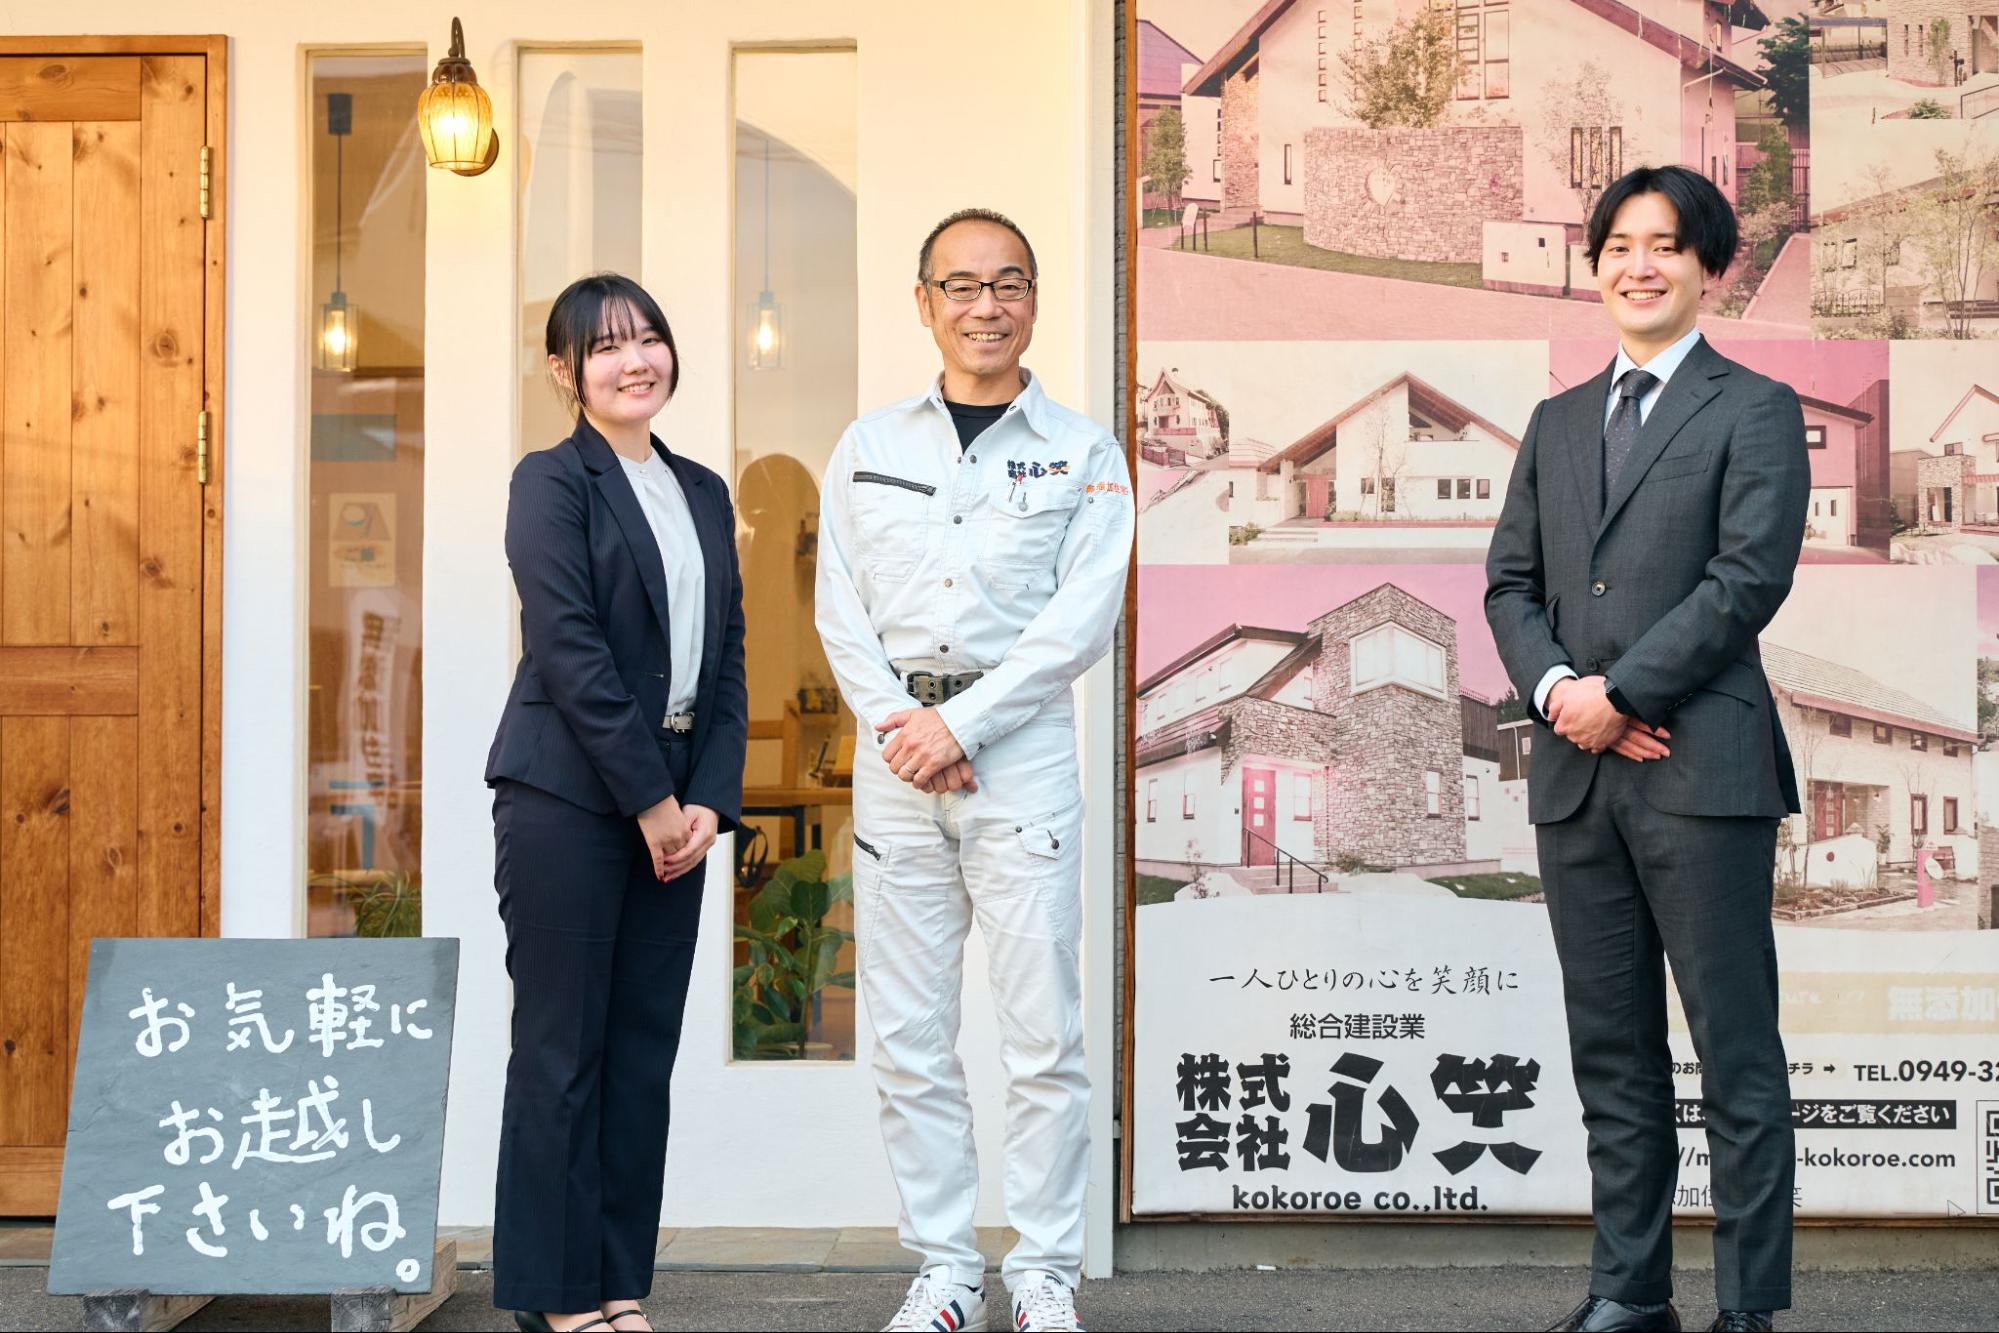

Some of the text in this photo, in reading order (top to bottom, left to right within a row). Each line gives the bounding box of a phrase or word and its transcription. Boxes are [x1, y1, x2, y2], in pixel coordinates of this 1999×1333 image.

[1208, 965, 1520, 996] 一人ひとりの心を笑顔に
[129, 973, 433, 1057] お気軽に
[1887, 986, 1999, 1021] 無添加
[1289, 1013, 1426, 1040] 総合建設業
[1854, 1060, 1999, 1082] TEL.0949-3
[159, 1075, 401, 1170] お越し
[1232, 1184, 1489, 1213] kokoroe co.,ltd.
[107, 1181, 421, 1282] 下さいね。
